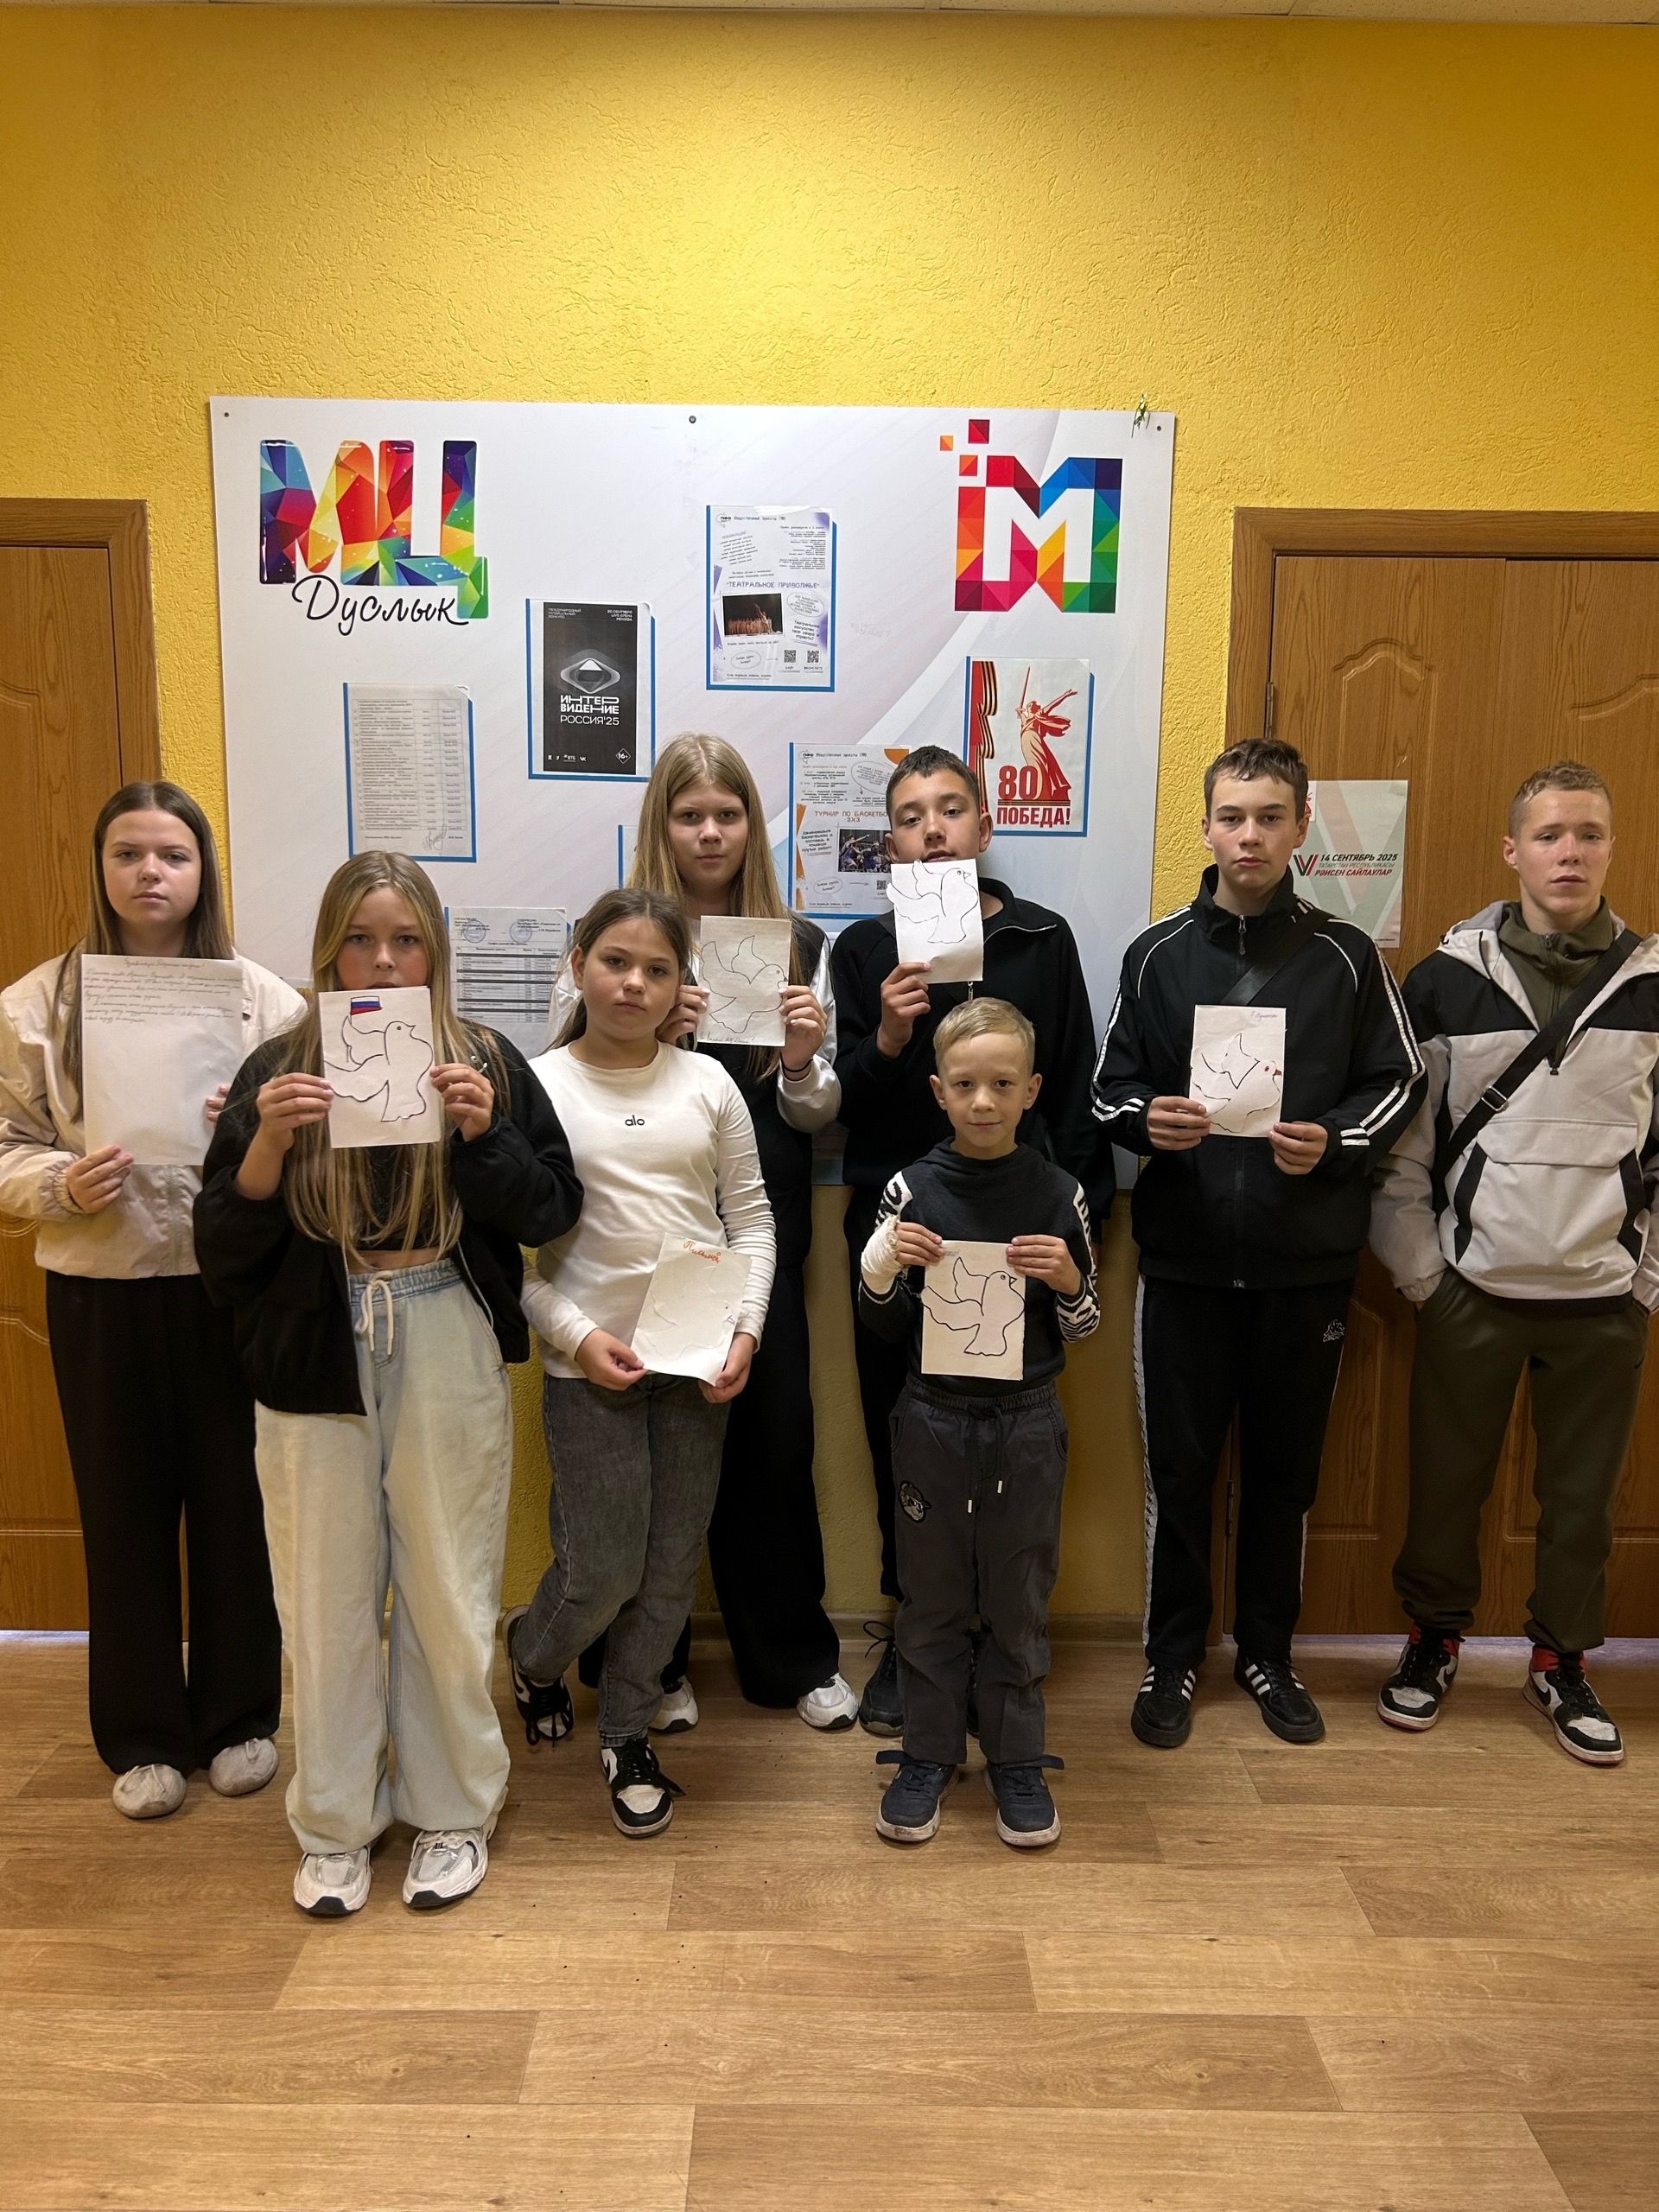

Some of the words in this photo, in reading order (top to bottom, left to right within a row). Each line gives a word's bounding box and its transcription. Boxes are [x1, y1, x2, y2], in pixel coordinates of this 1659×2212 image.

[292, 575, 469, 636] Дуслык
[560, 695, 620, 704] ИНТЕР
[560, 703, 620, 715] ВИДЕНИЕ
[560, 715, 620, 726] РОССИЯ'25
[998, 765, 1038, 800] 80
[996, 807, 1071, 828] ПОБЕДА!
[1376, 853, 1398, 861] 2025
[625, 1115, 645, 1127] alo
